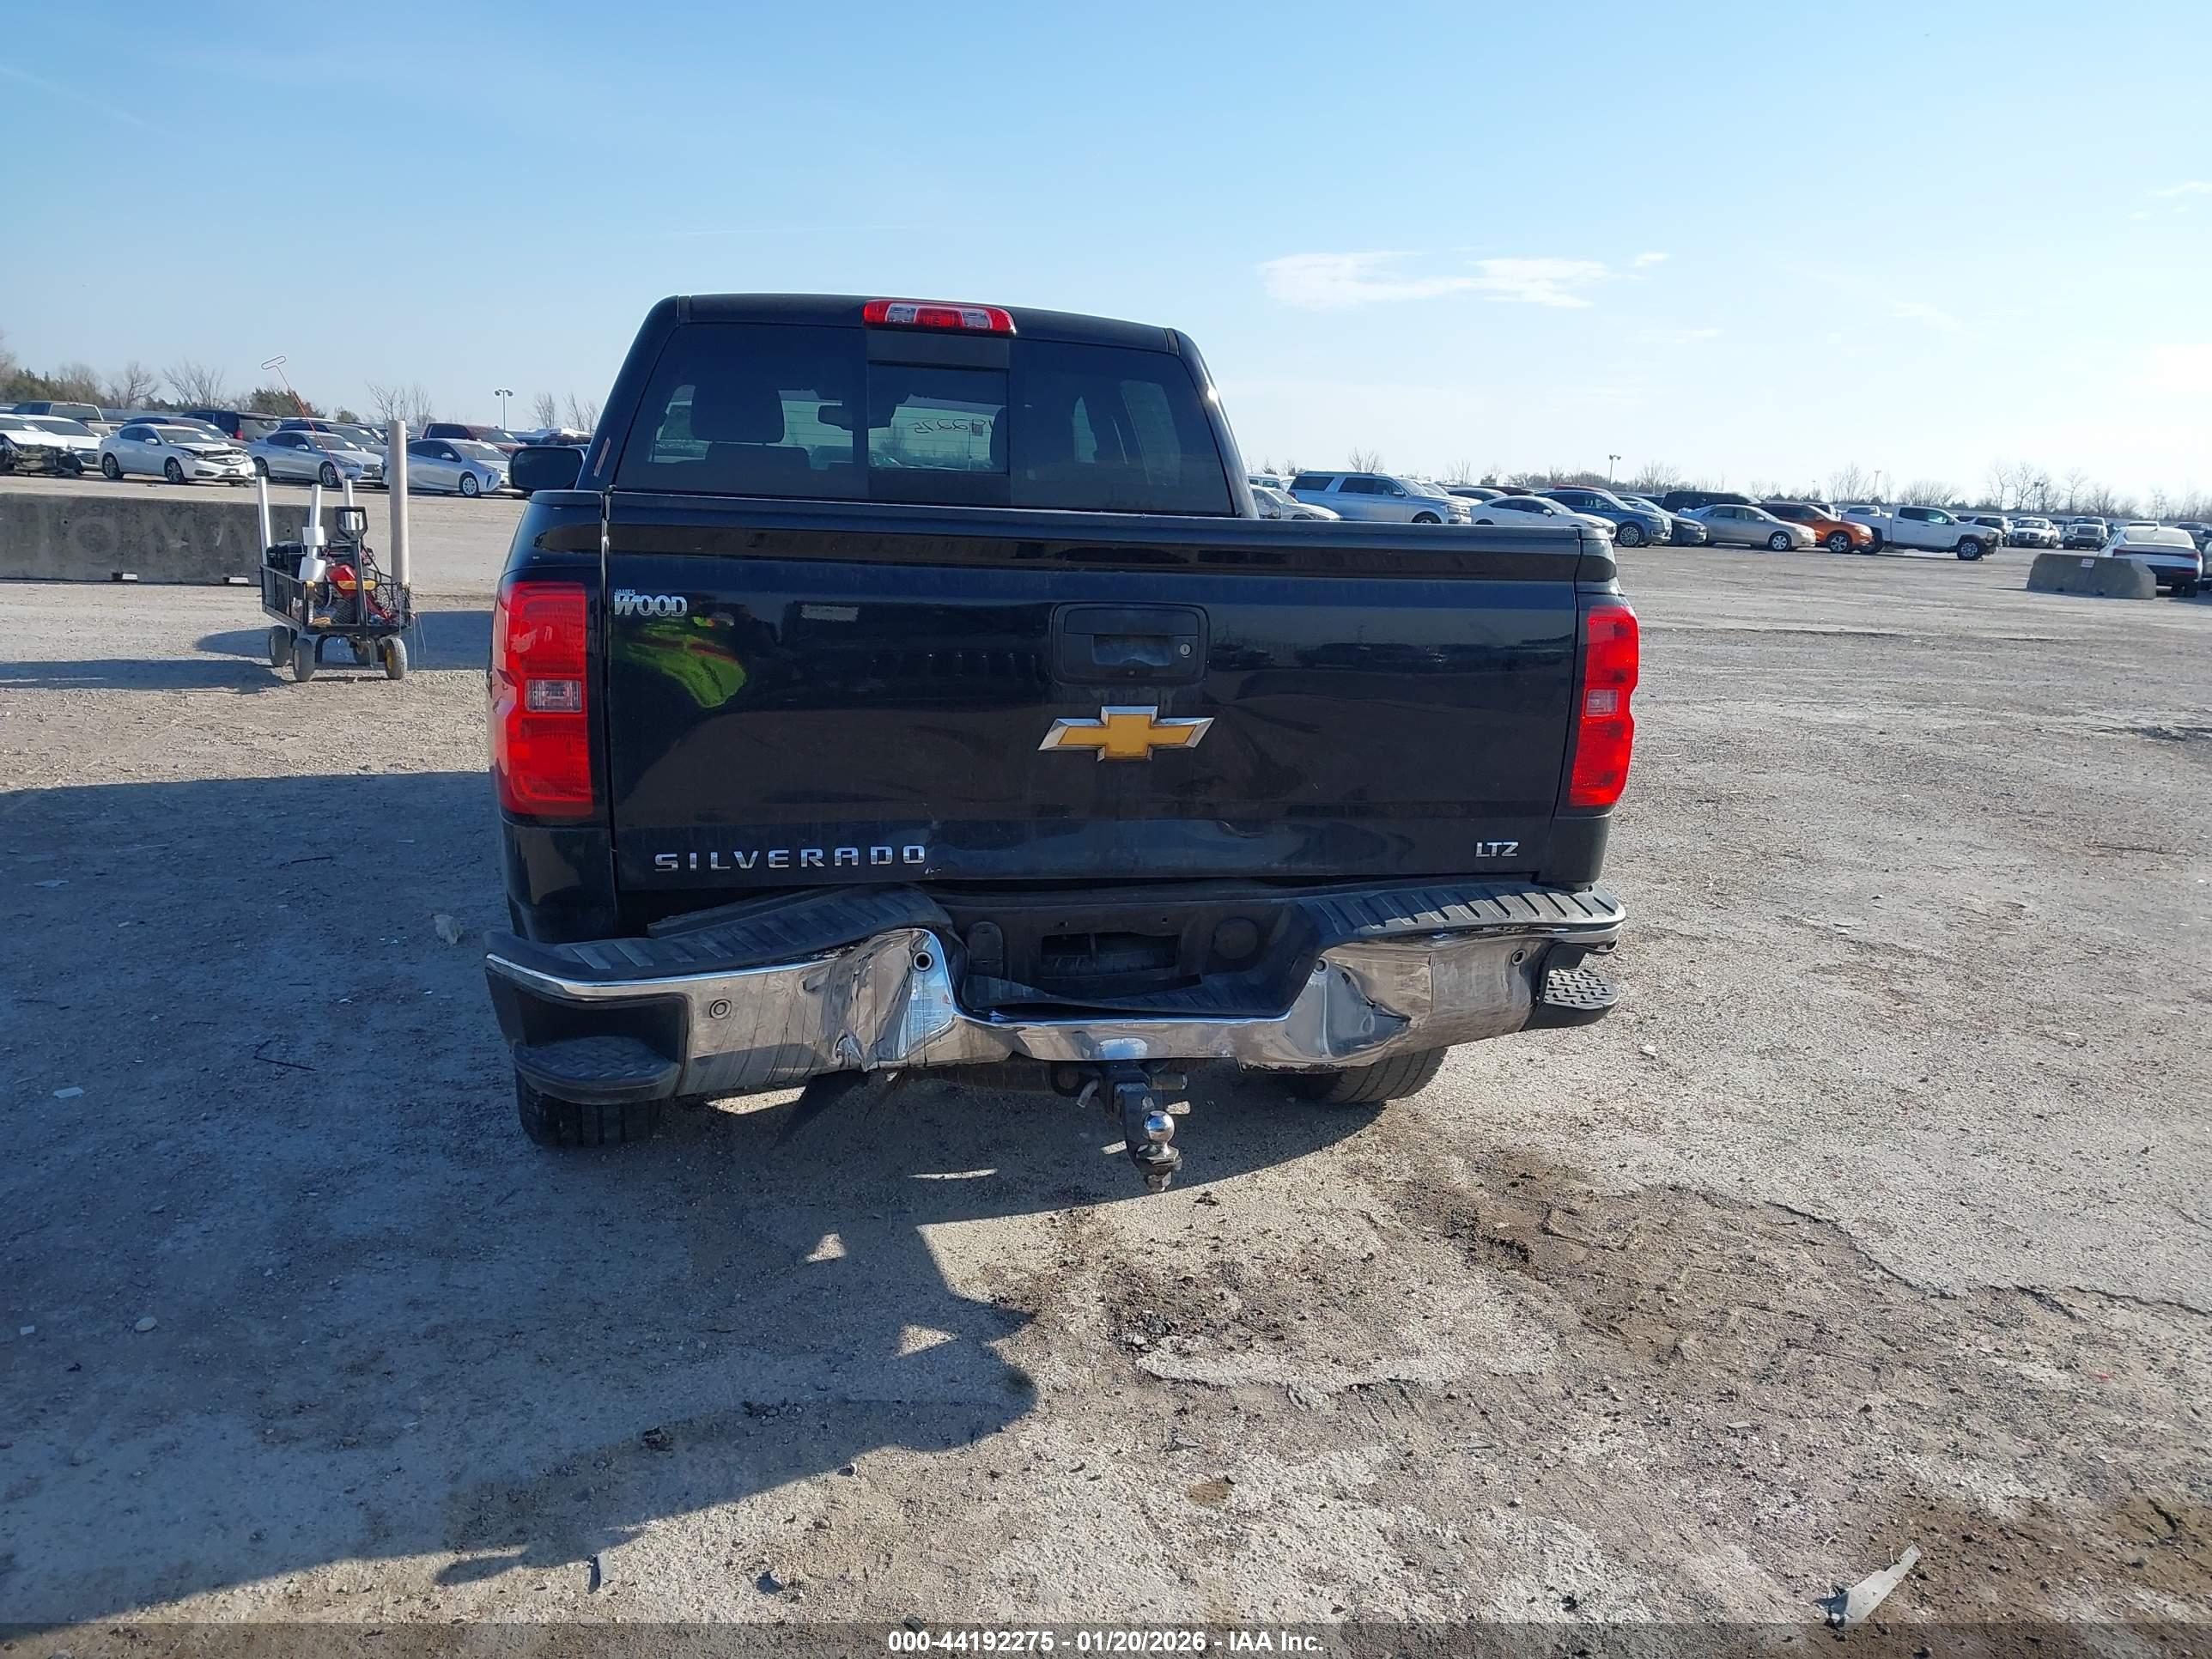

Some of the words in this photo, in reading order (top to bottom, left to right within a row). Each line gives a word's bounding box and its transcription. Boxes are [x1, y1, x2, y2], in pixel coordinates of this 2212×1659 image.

[614, 594, 687, 617] WOOD
[654, 845, 926, 872] SILVERADO
[1476, 842, 1519, 857] LTZ
